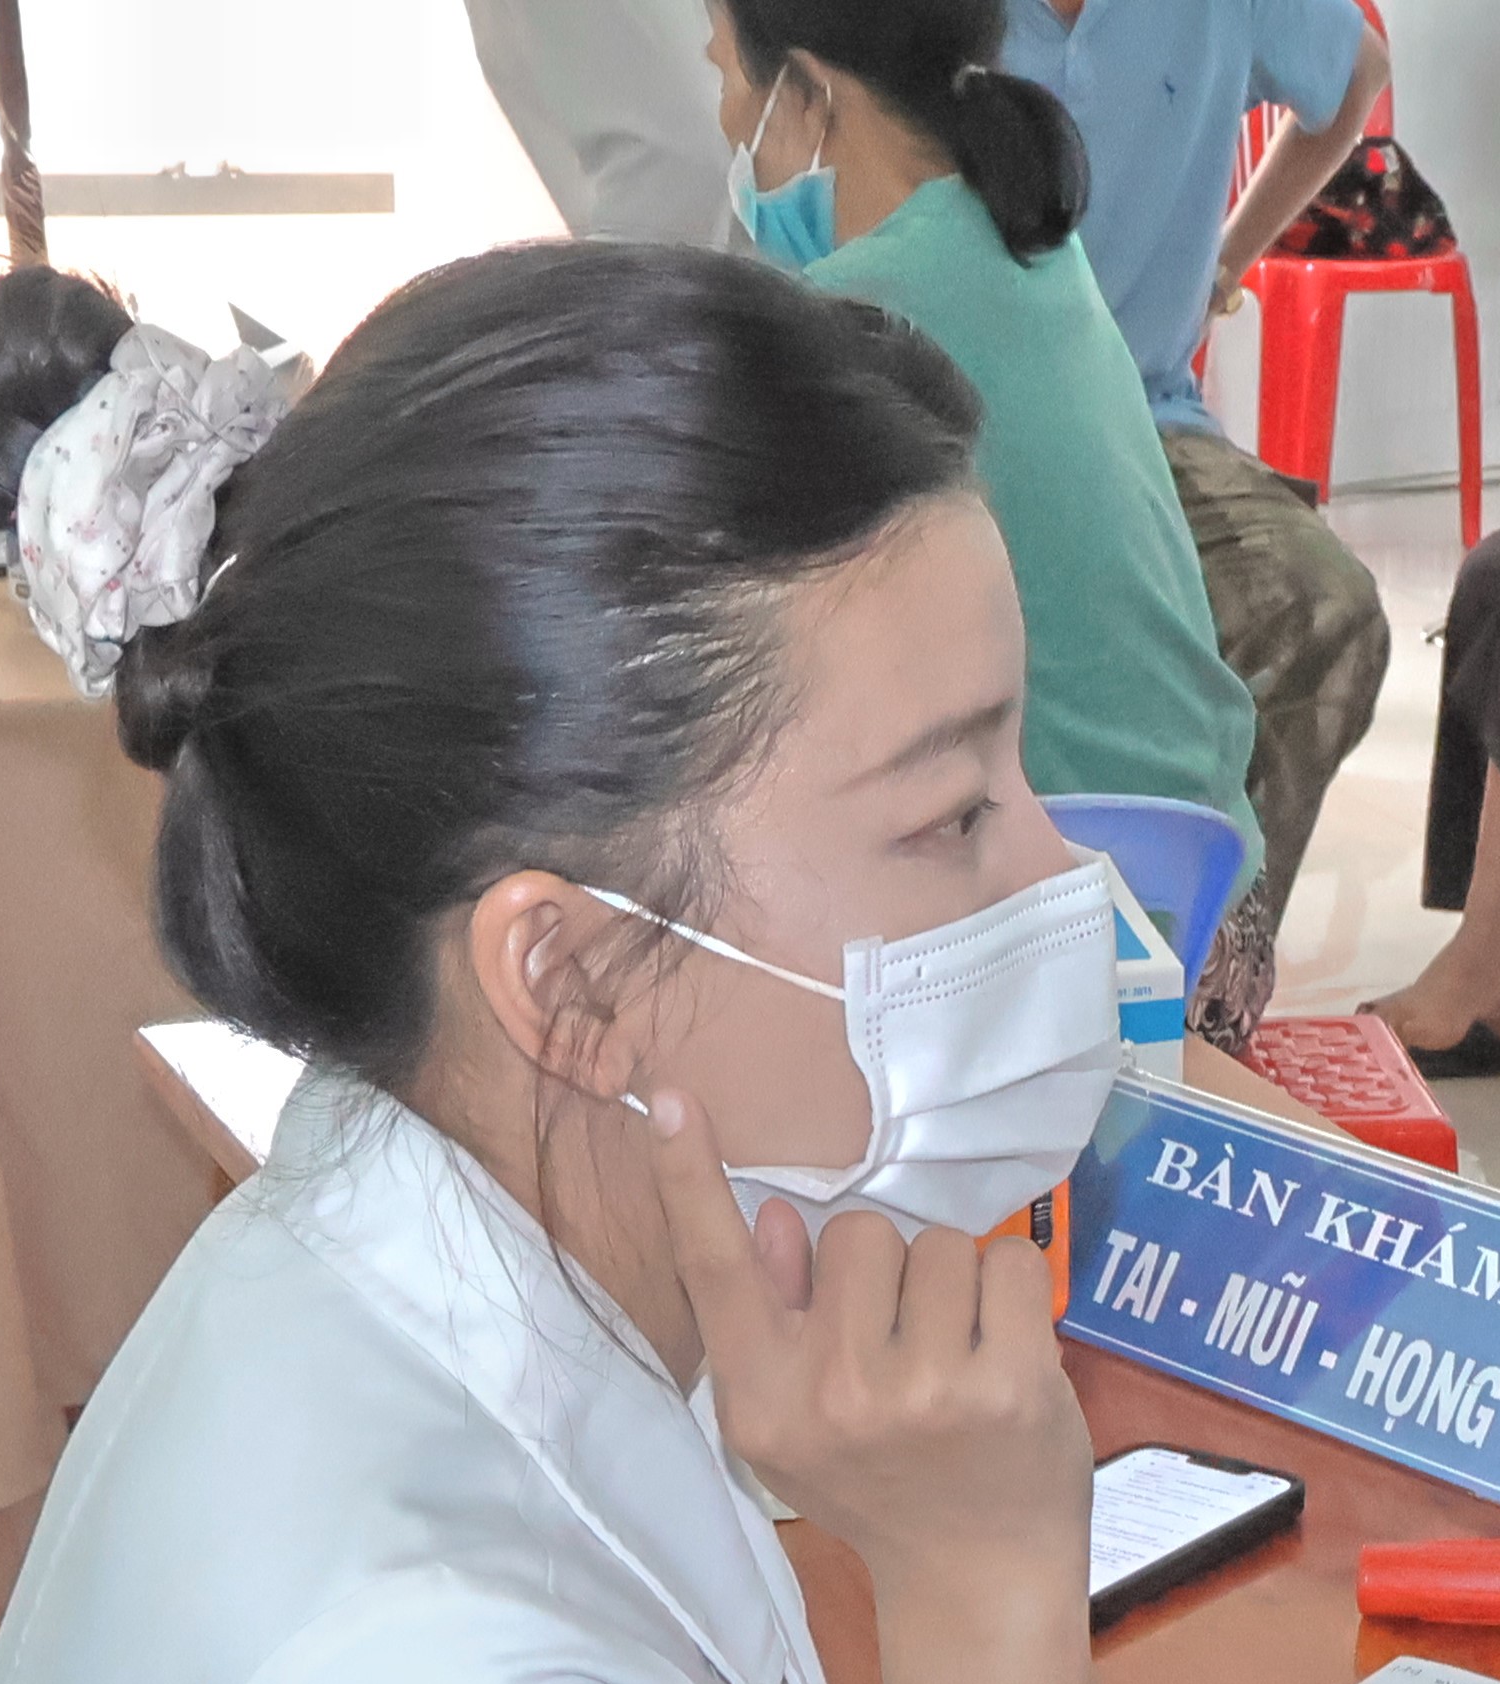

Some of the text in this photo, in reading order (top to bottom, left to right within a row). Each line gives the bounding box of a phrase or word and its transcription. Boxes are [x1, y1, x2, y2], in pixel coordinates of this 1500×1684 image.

[1146, 1138, 1300, 1227] BÀN
[1092, 1228, 1180, 1324] TAI
[1205, 1272, 1319, 1376] MŨI
